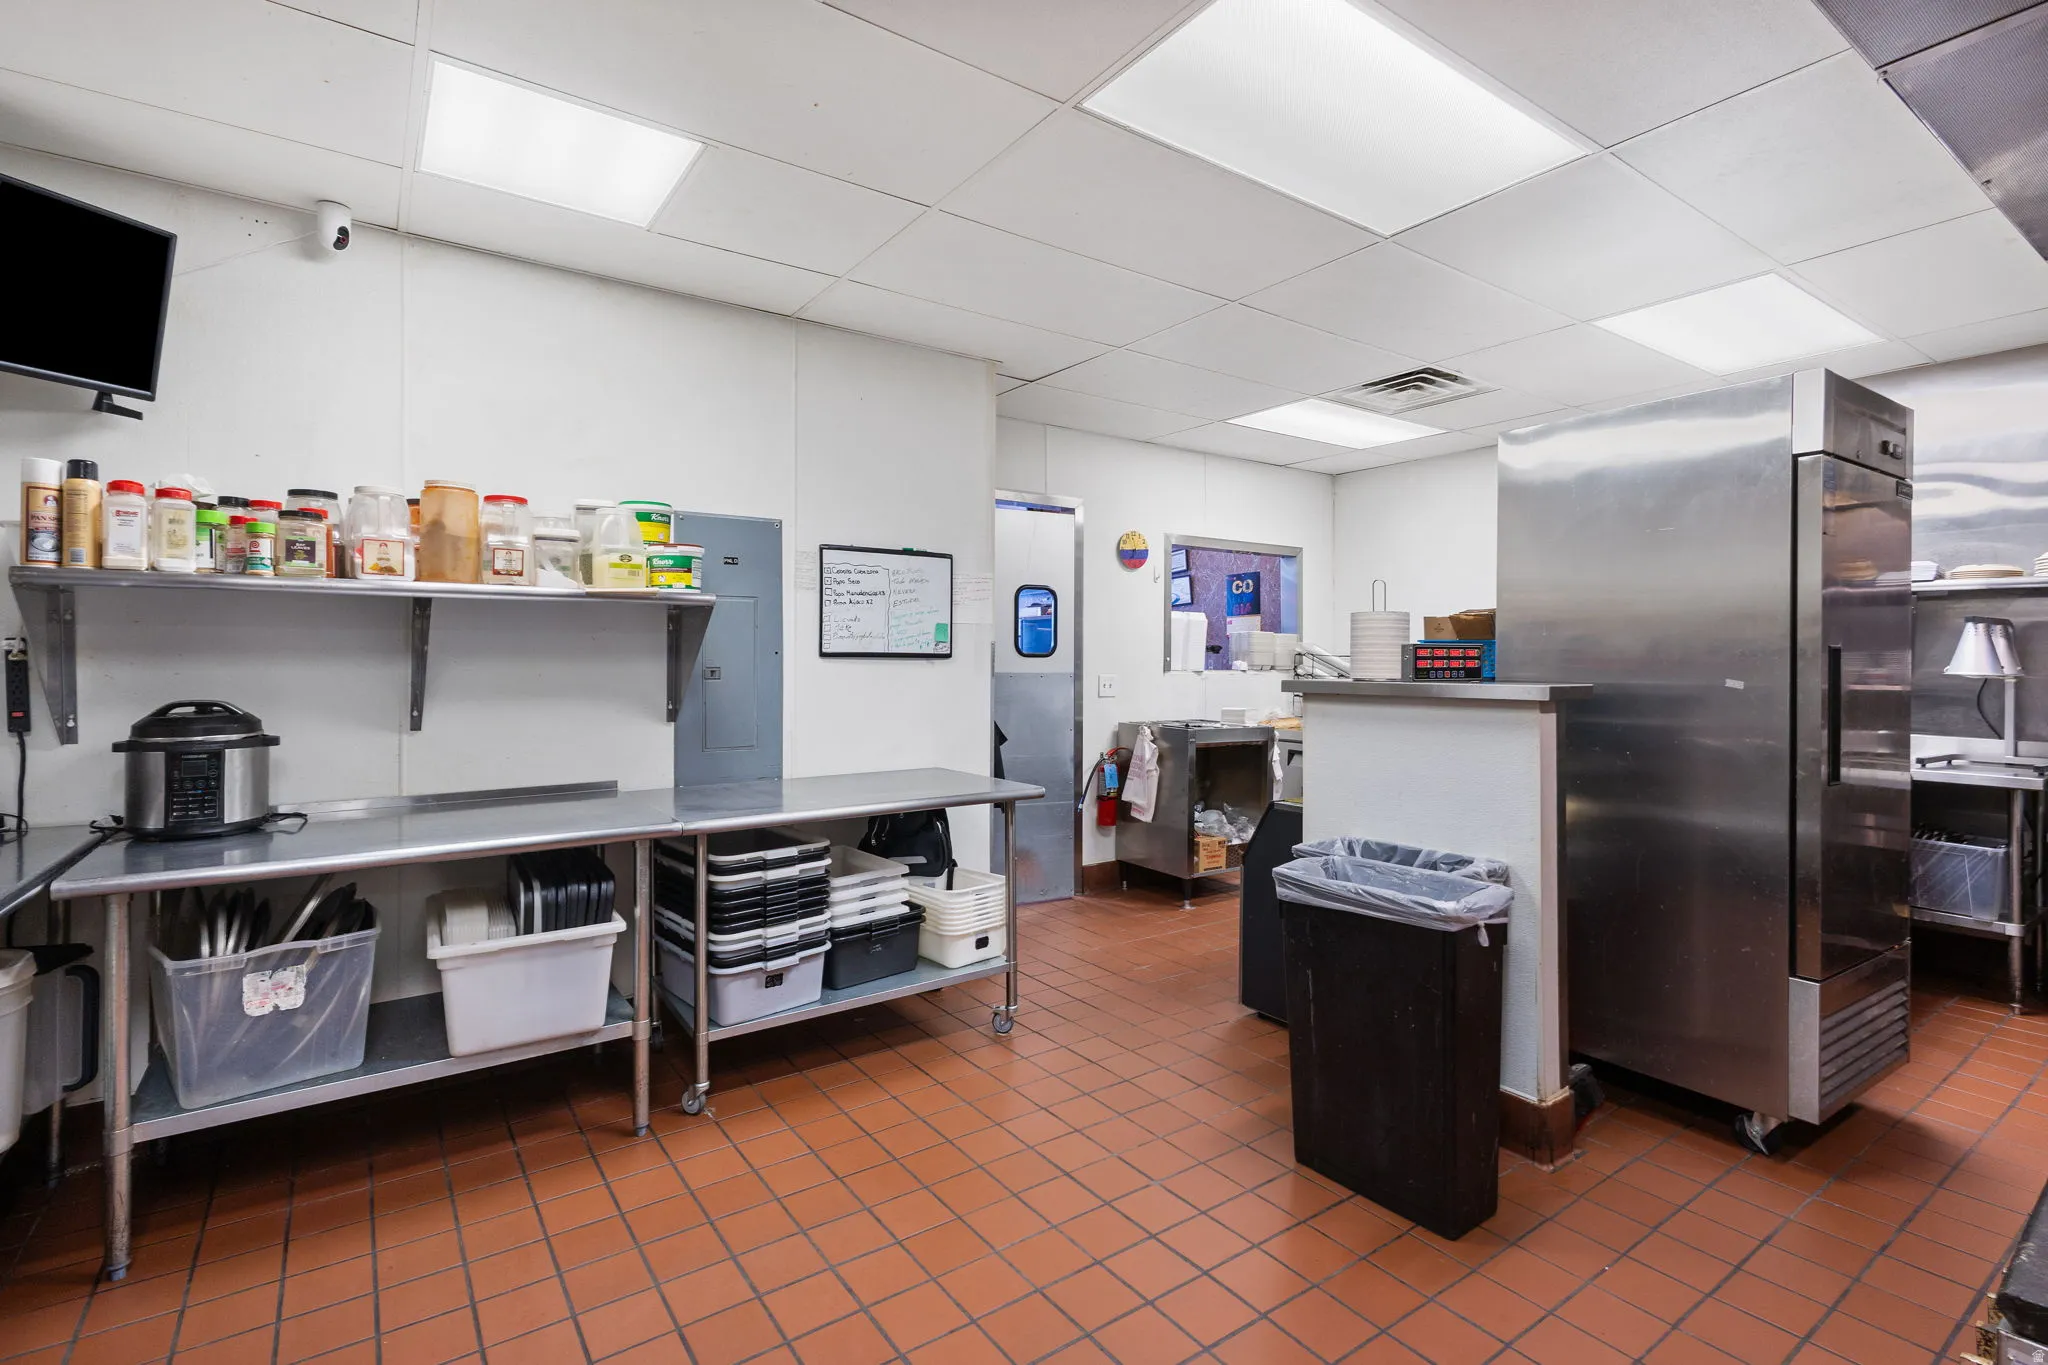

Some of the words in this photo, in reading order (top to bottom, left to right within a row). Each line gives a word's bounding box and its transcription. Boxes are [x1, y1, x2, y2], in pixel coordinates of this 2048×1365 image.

[650, 513, 669, 522] Knorr
[652, 557, 674, 565] Knorr
[1232, 579, 1254, 594] CO
